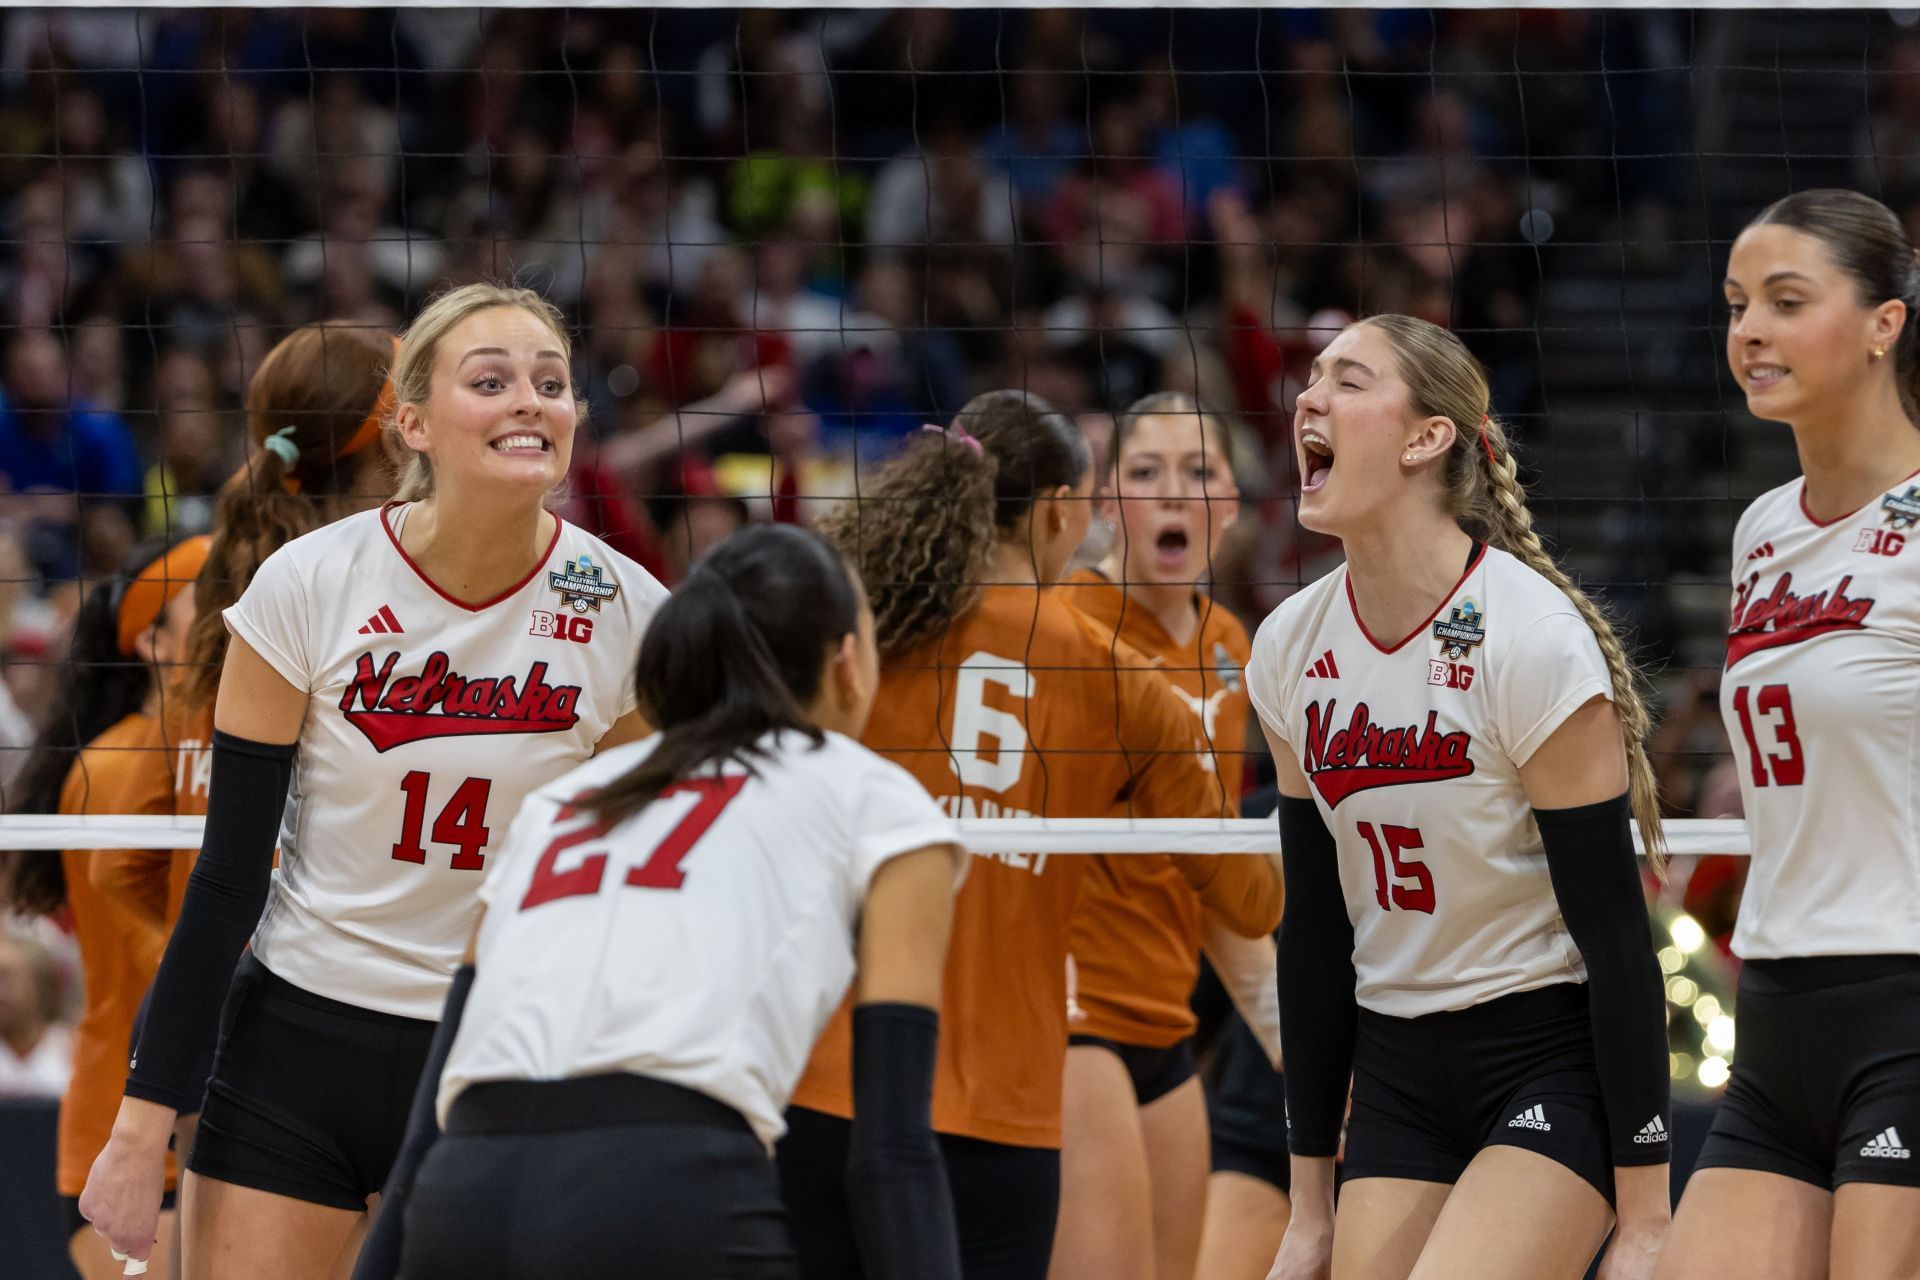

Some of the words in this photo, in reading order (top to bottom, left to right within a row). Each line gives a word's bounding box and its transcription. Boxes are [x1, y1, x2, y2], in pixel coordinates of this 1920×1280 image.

[554, 578, 614, 596] CHAMPIONSHIP
[1437, 626, 1483, 642] CHAMPIONSHIP
[339, 651, 583, 726] Nebraska
[949, 650, 1036, 794] 6
[1304, 697, 1474, 775] Nebraska
[1733, 683, 1805, 787] 13
[391, 770, 492, 870] 14
[518, 774, 750, 912] 27
[1356, 820, 1437, 915] 15
[1508, 1118, 1551, 1132] adidas
[1633, 1131, 1668, 1144] adidas
[1860, 1145, 1911, 1159] adidas
